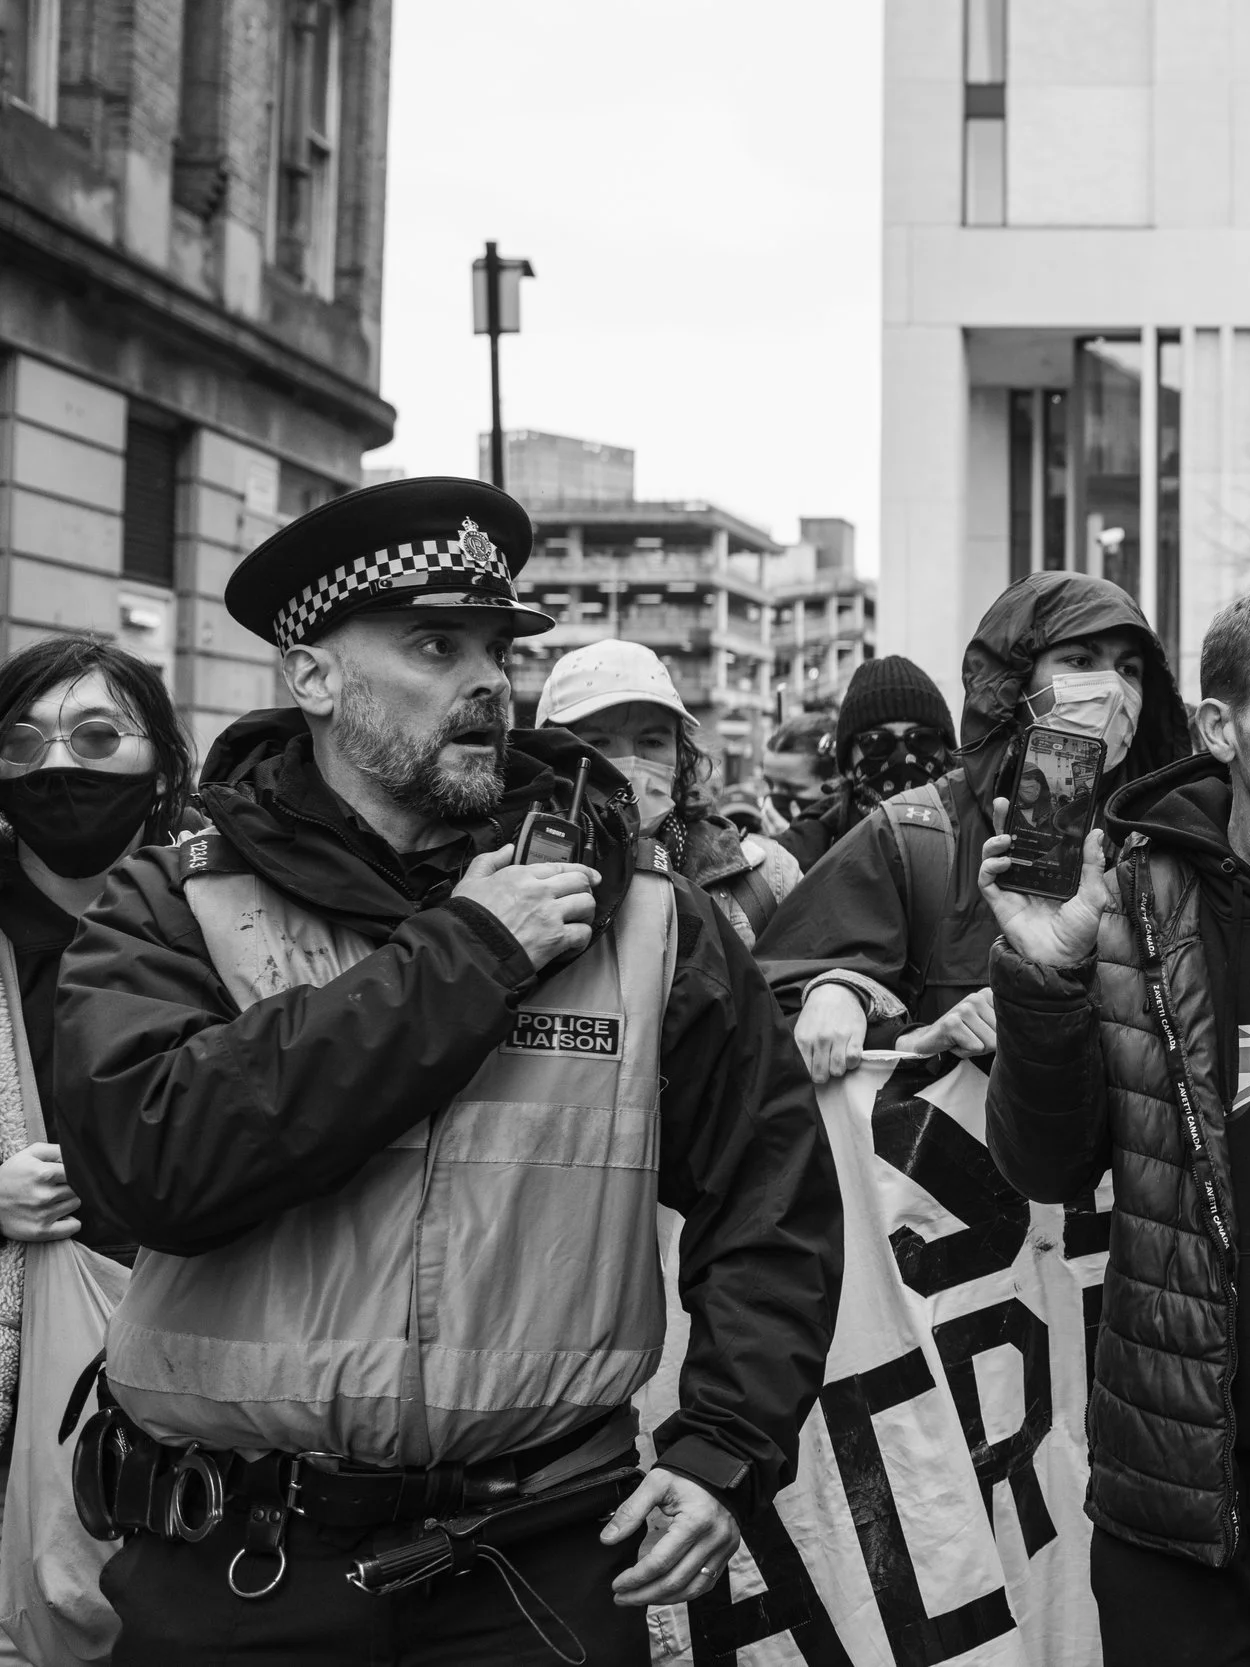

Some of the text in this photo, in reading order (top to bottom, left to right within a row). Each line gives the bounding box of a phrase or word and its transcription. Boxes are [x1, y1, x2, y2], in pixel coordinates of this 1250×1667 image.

[1145, 923, 1156, 958] CANADA
[512, 1030, 613, 1051] LIAISON
[518, 1013, 610, 1035] POLICE
[1153, 984, 1177, 1051] ZAVETTI CANADA
[1177, 1081, 1202, 1151] ZAVETTI CANADA
[1204, 1180, 1230, 1250] ZAVETTI CANADA
